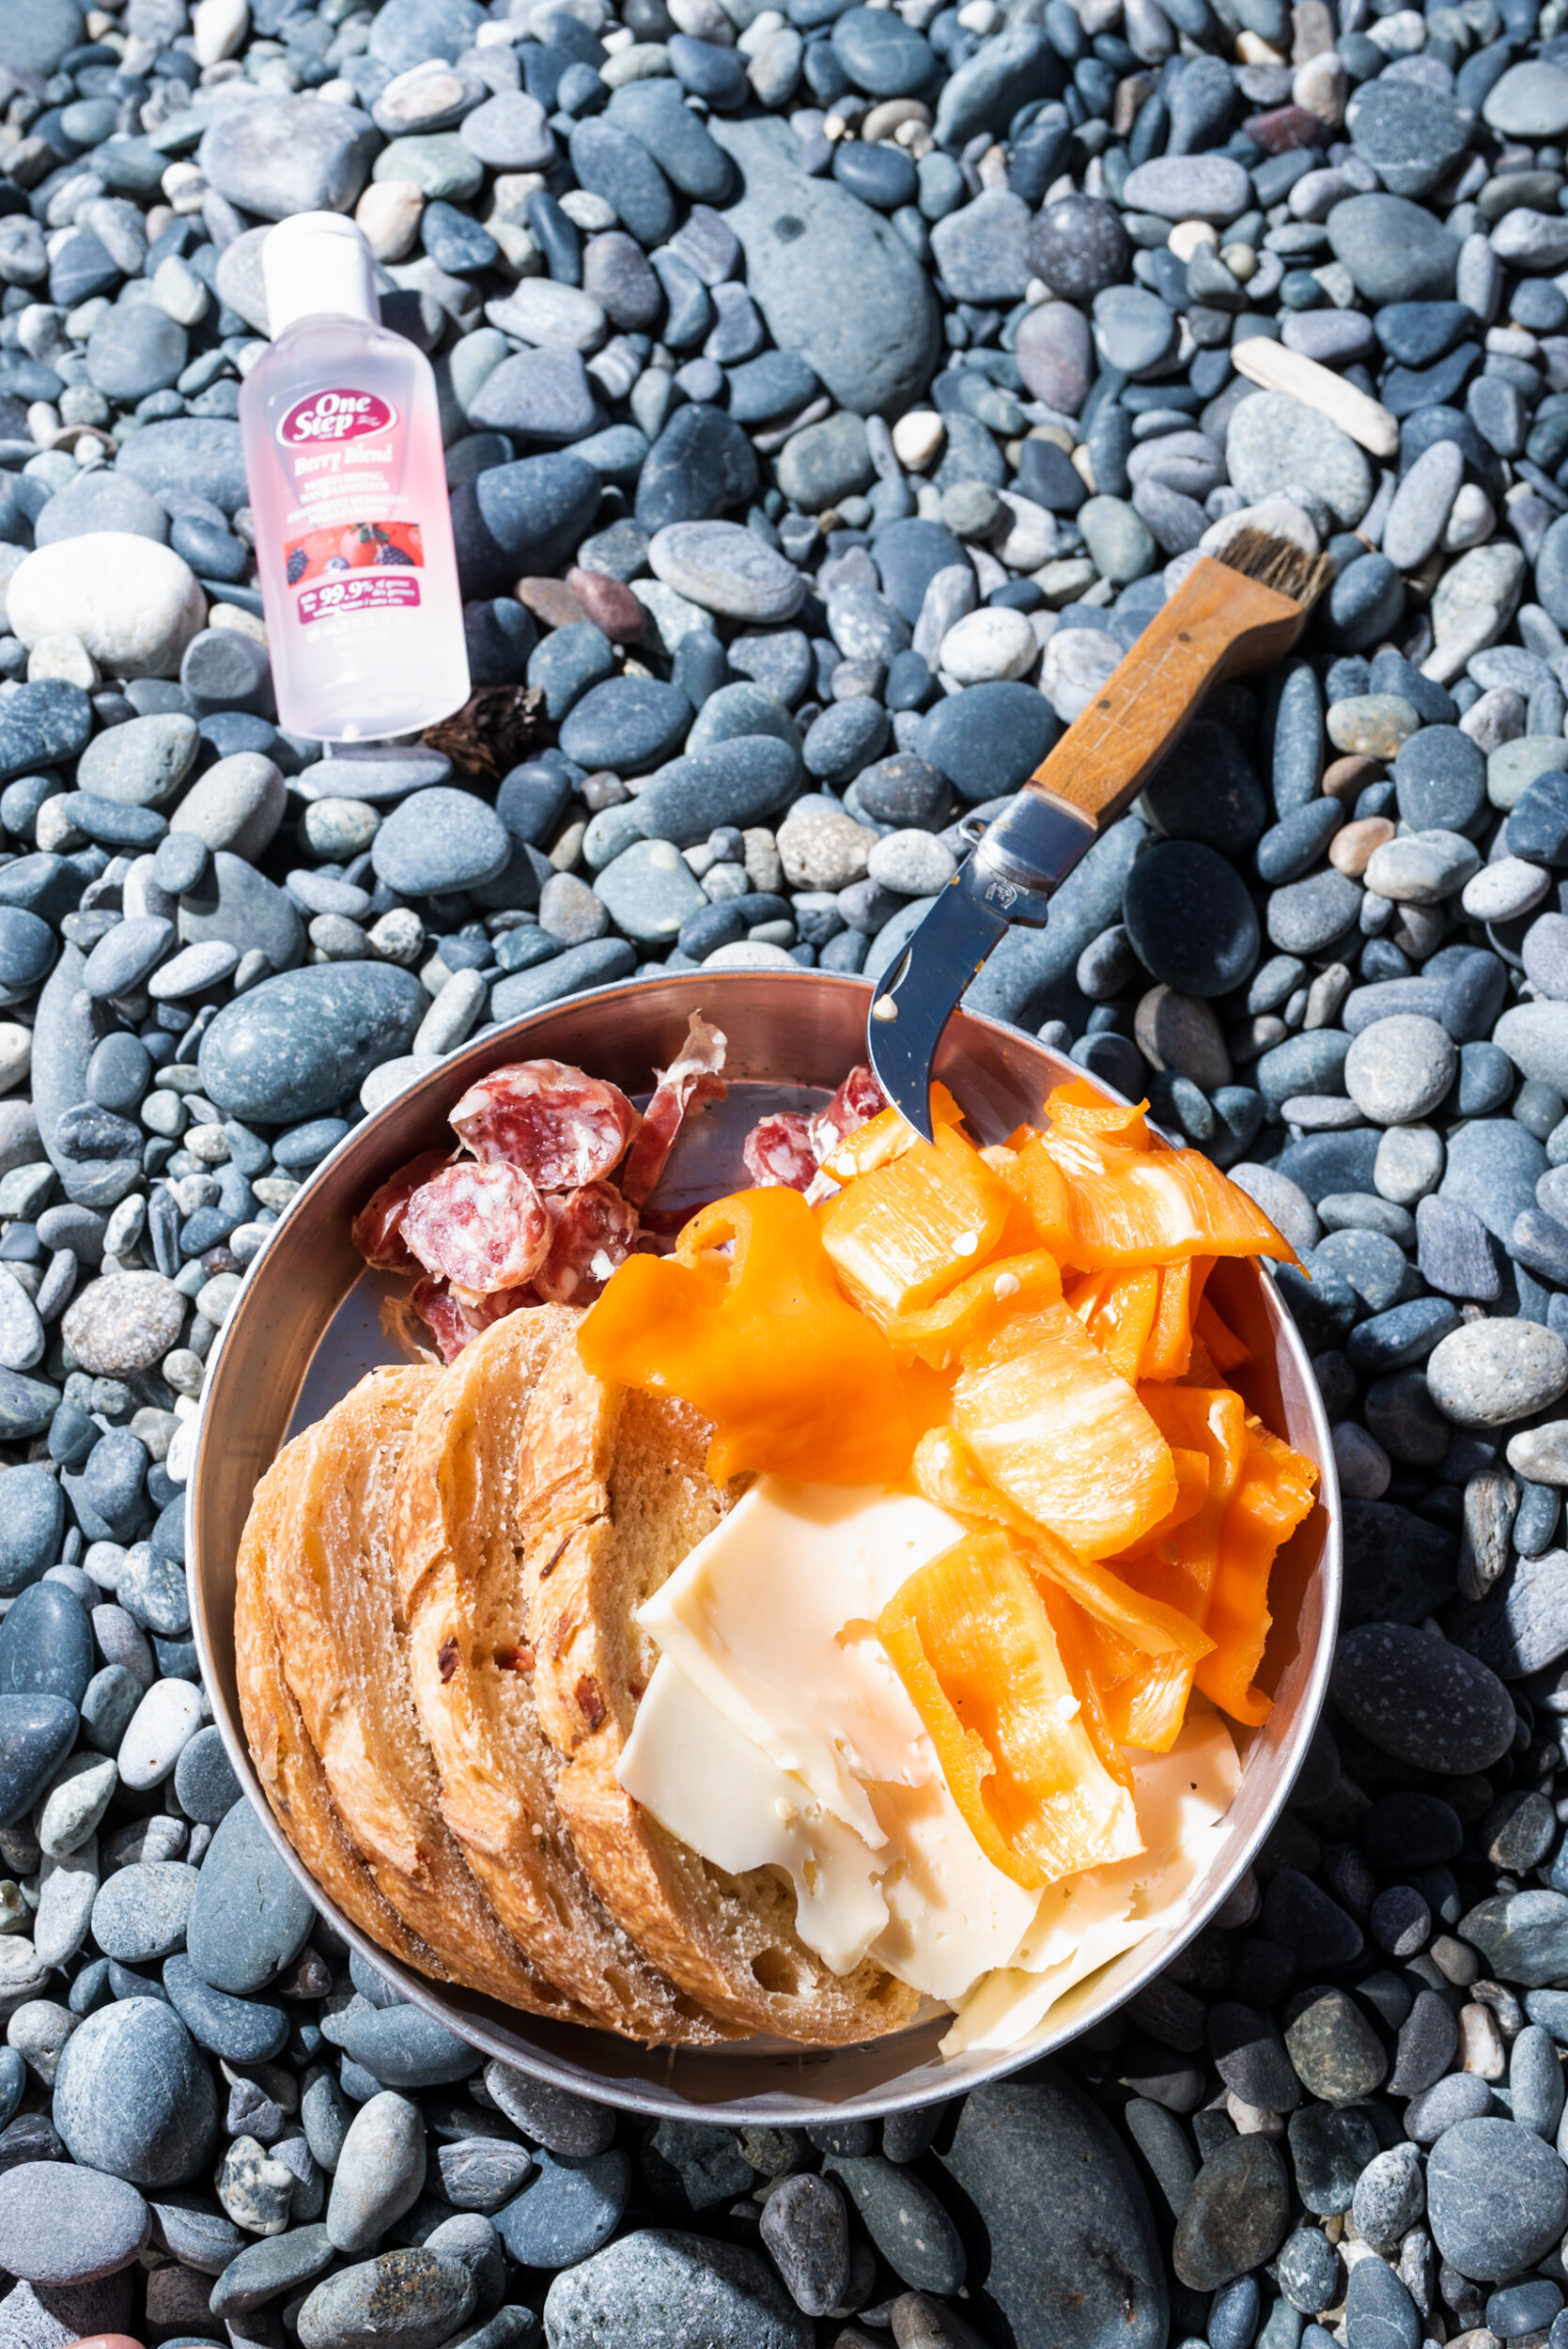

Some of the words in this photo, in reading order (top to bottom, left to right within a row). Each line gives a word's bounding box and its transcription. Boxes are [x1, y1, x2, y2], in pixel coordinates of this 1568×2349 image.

[316, 393, 372, 417] One
[293, 411, 354, 441] Step
[293, 451, 341, 476] Berry
[344, 443, 394, 464] Blend
[319, 580, 374, 606] 99.9%
